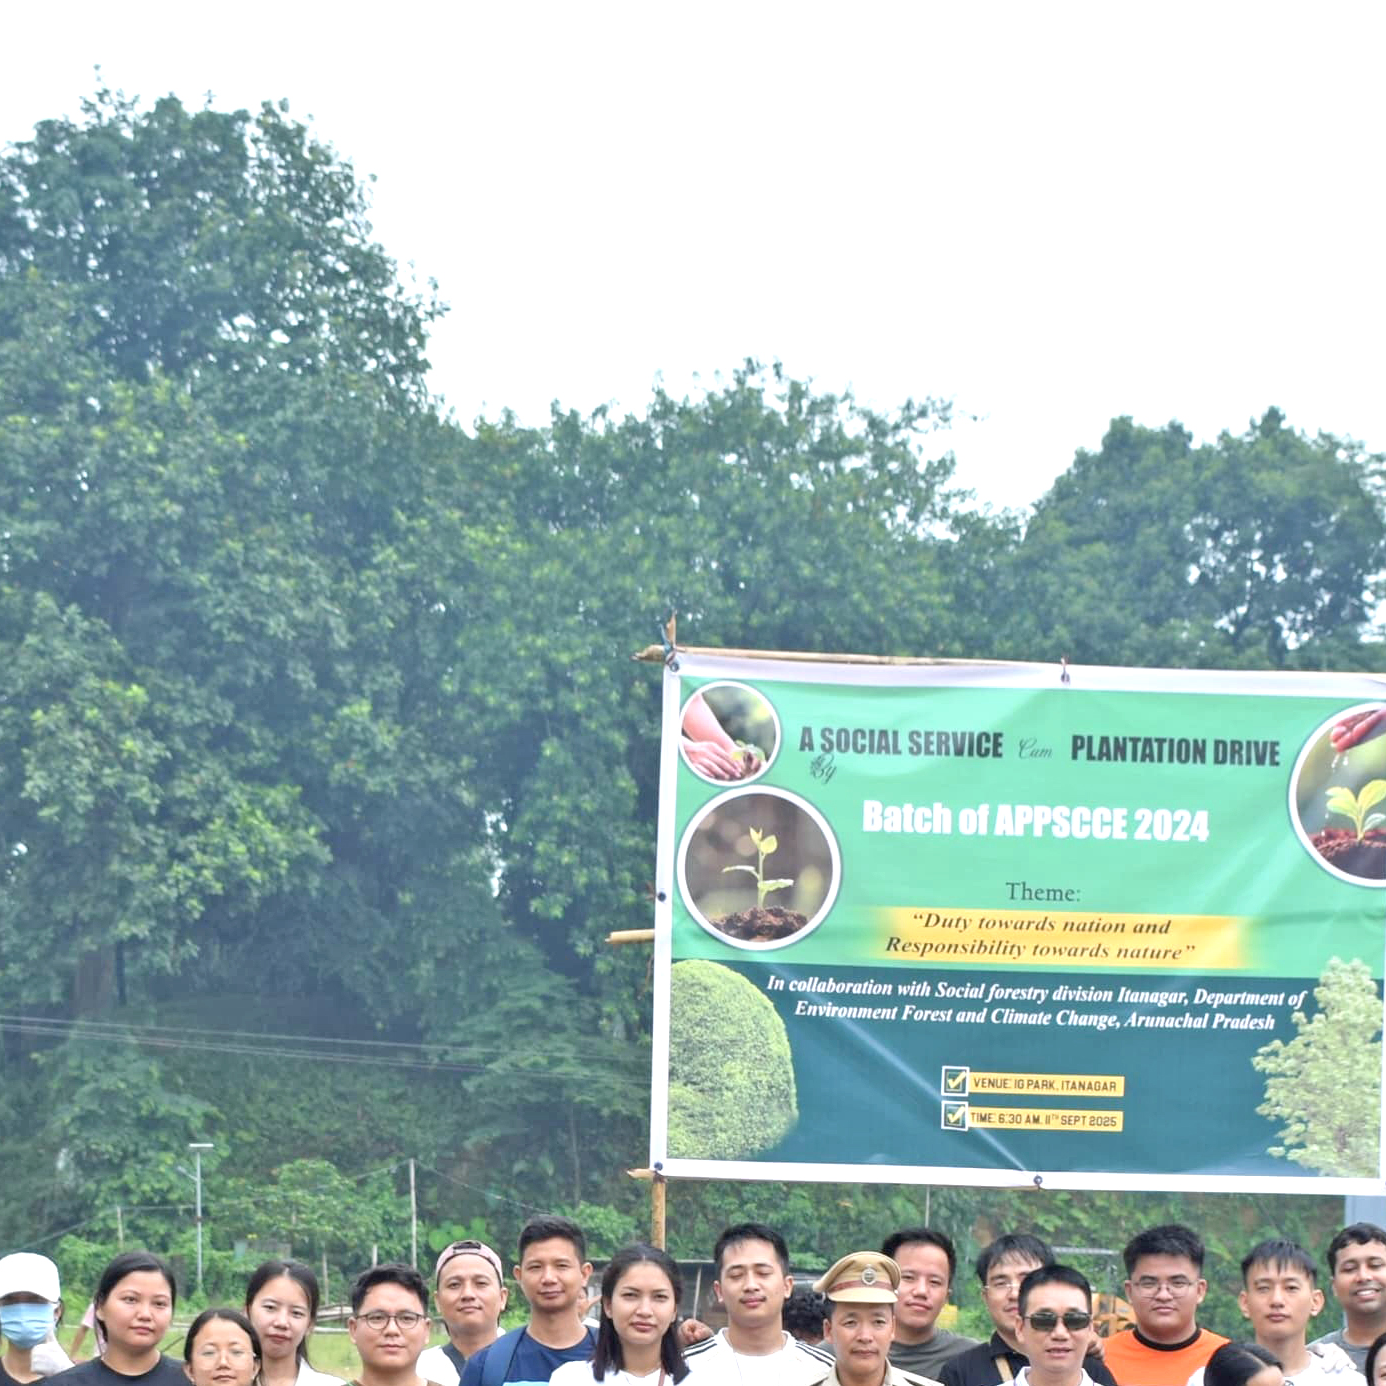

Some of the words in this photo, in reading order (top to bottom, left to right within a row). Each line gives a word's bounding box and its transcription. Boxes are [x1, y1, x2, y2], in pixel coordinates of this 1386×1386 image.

[799, 727, 814, 752] A
[821, 727, 901, 755] SOCIAL
[908, 730, 1003, 758] SERVICE
[1071, 734, 1206, 764] PLANTATION
[1213, 739, 1280, 767] DRIVE
[862, 800, 952, 834] Batch
[958, 803, 989, 836] of
[993, 804, 1127, 840] APPSCCE
[1134, 808, 1209, 842] 2024
[1005, 882, 1081, 902] Theme:
[978, 915, 1056, 932] towards
[1062, 917, 1126, 933] nation
[1132, 919, 1171, 934] and
[885, 936, 1027, 960] Responsibility
[1031, 943, 1110, 958] towards
[767, 975, 784, 990] In
[788, 977, 893, 996] collaboration
[897, 980, 931, 997] with
[935, 981, 986, 999] Social
[984, 983, 1048, 1004] forestry
[1052, 985, 1113, 1002] division
[1117, 987, 1189, 1007] Itanagar,
[1193, 988, 1286, 1009] Department
[1288, 990, 1308, 1010] of
[795, 1001, 897, 1020] Environment
[901, 1004, 953, 1022] Forest
[956, 1008, 987, 1024] and
[990, 1008, 1052, 1025] Climate
[1056, 1010, 1121, 1031] Change,
[1124, 1012, 1209, 1029] Arunachal
[1212, 1013, 1276, 1030] Pradesh
[1061, 1081, 1117, 1091] ITANAGAR
[1061, 1115, 1087, 1126] SEPT
[1089, 1116, 1117, 1127] 2025
